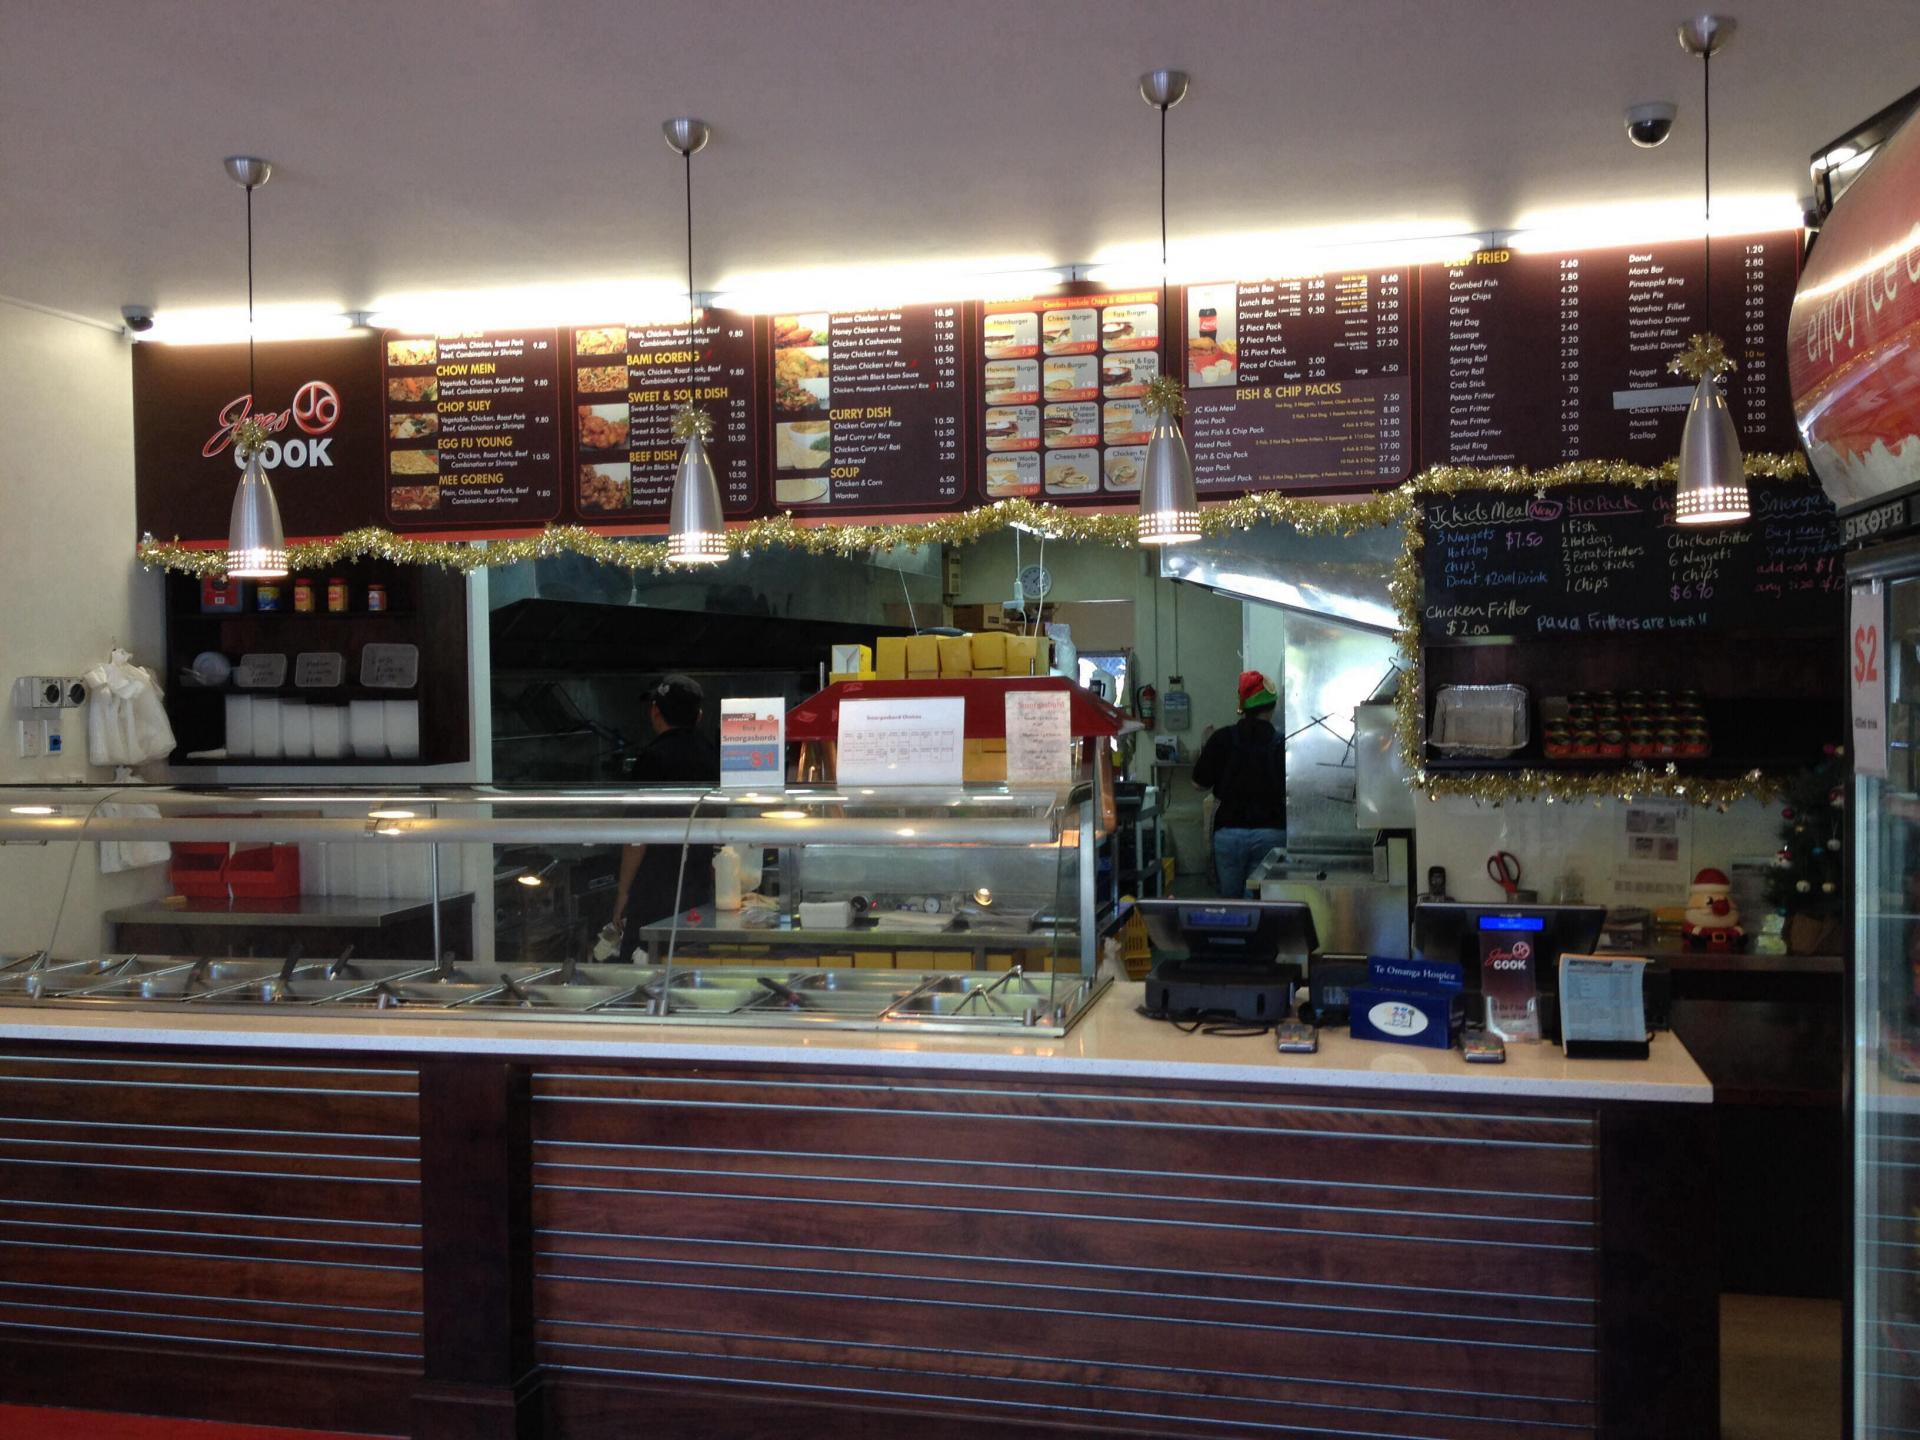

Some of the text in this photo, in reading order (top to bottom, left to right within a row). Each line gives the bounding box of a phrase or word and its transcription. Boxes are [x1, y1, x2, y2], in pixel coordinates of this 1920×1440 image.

[1746, 246, 1763, 254] 1.20
[1477, 251, 1510, 264] FRIED
[1629, 254, 1652, 263] Donut
[1745, 258, 1763, 267] 2.80
[1629, 266, 1663, 275] Moro Bar
[1561, 273, 1578, 281] 2.80
[1450, 279, 1498, 290] Crumbed Fish
[1629, 278, 1684, 288] Pineapple Ring
[1561, 285, 1578, 293] 4.20
[1450, 293, 1491, 303] Large Chips
[1629, 293, 1650, 301] Apple
[1240, 310, 1277, 320] Dinner Box
[1308, 306, 1325, 315] 9.30
[1450, 307, 1469, 315] Chips
[1377, 313, 1398, 322] 14.00
[1665, 315, 1690, 323] Dinner
[1240, 322, 1282, 332] 5 Piece Pack
[1465, 319, 1479, 327] Dog
[1561, 323, 1578, 331] 2.40
[1377, 326, 1398, 335] 22.50
[1240, 337, 1244, 345] 9
[1247, 336, 1264, 344] Piece
[1450, 332, 1479, 340] Sausage
[833, 340, 857, 348] Chicken
[865, 337, 902, 345] Cashewnuts
[1377, 339, 1398, 348] 37.20
[1240, 347, 1287, 357] 15 Piece Pack
[627, 352, 700, 365] BAMI GORENG
[1308, 357, 1325, 365] 3.00
[1450, 355, 1488, 366] Spring Roll
[1240, 359, 1296, 370] Piece of Chicken
[1561, 361, 1578, 369] 2.00
[436, 363, 495, 376] CHOW MEIN
[1309, 369, 1325, 377] 2.60
[1450, 369, 1470, 377] Curry
[1629, 369, 1657, 377] Nugget
[1240, 373, 1259, 382] Chips
[1450, 380, 1485, 389] Crab Stick
[628, 393, 660, 403] SWEET
[663, 392, 670, 400] &
[705, 388, 728, 398] DISH
[1236, 383, 1341, 400] FISH & CHIP PACKS
[437, 401, 491, 412] CHOP SUEY
[1194, 404, 1236, 414] JC Kids Meal
[830, 407, 891, 420] CURRY DISH
[860, 421, 877, 429] Curry
[1195, 417, 1209, 425] Mini
[1630, 419, 1658, 427] Mussels
[1380, 430, 1400, 438] 18.30
[1450, 429, 1502, 438] Seafood Fritter
[438, 437, 512, 449] EGG FU YOUNG
[1450, 442, 1488, 451] Squid Ring
[629, 451, 677, 462] BEEF DISH
[831, 467, 860, 478] SOUP
[1195, 463, 1231, 473] Mega Pack
[1379, 466, 1400, 474] 28.50
[439, 474, 503, 485] MEE GORENG
[1569, 520, 1597, 533] Fish
[1506, 532, 1543, 549] $7.50
[1575, 578, 1608, 593] Chips
[1855, 624, 1877, 689] $2
[1493, 960, 1527, 970] COOK
[1374, 965, 1456, 980] Te Omanga Hospice
